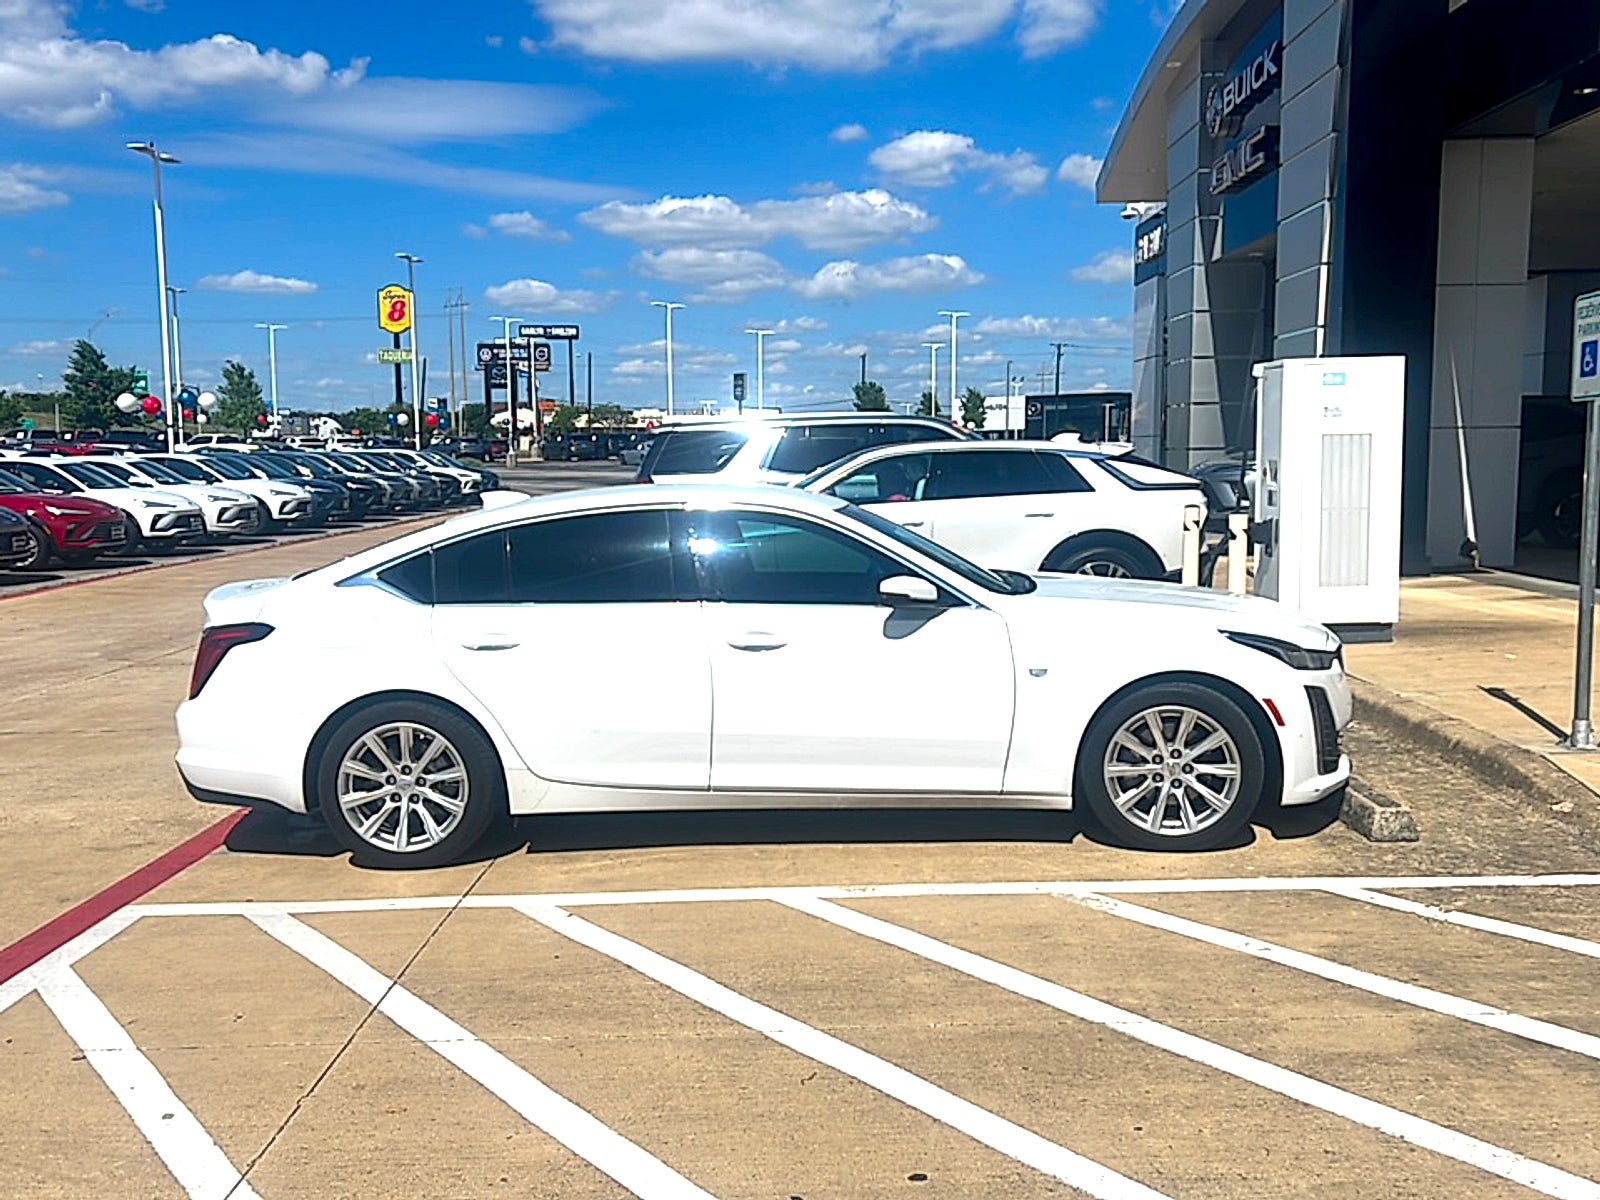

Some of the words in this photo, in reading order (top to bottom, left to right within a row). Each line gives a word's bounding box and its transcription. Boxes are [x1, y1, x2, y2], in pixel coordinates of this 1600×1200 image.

[1223, 40, 1278, 117] BUICK
[1209, 125, 1266, 195] GMC
[383, 290, 406, 304] Super
[388, 300, 406, 322] 8
